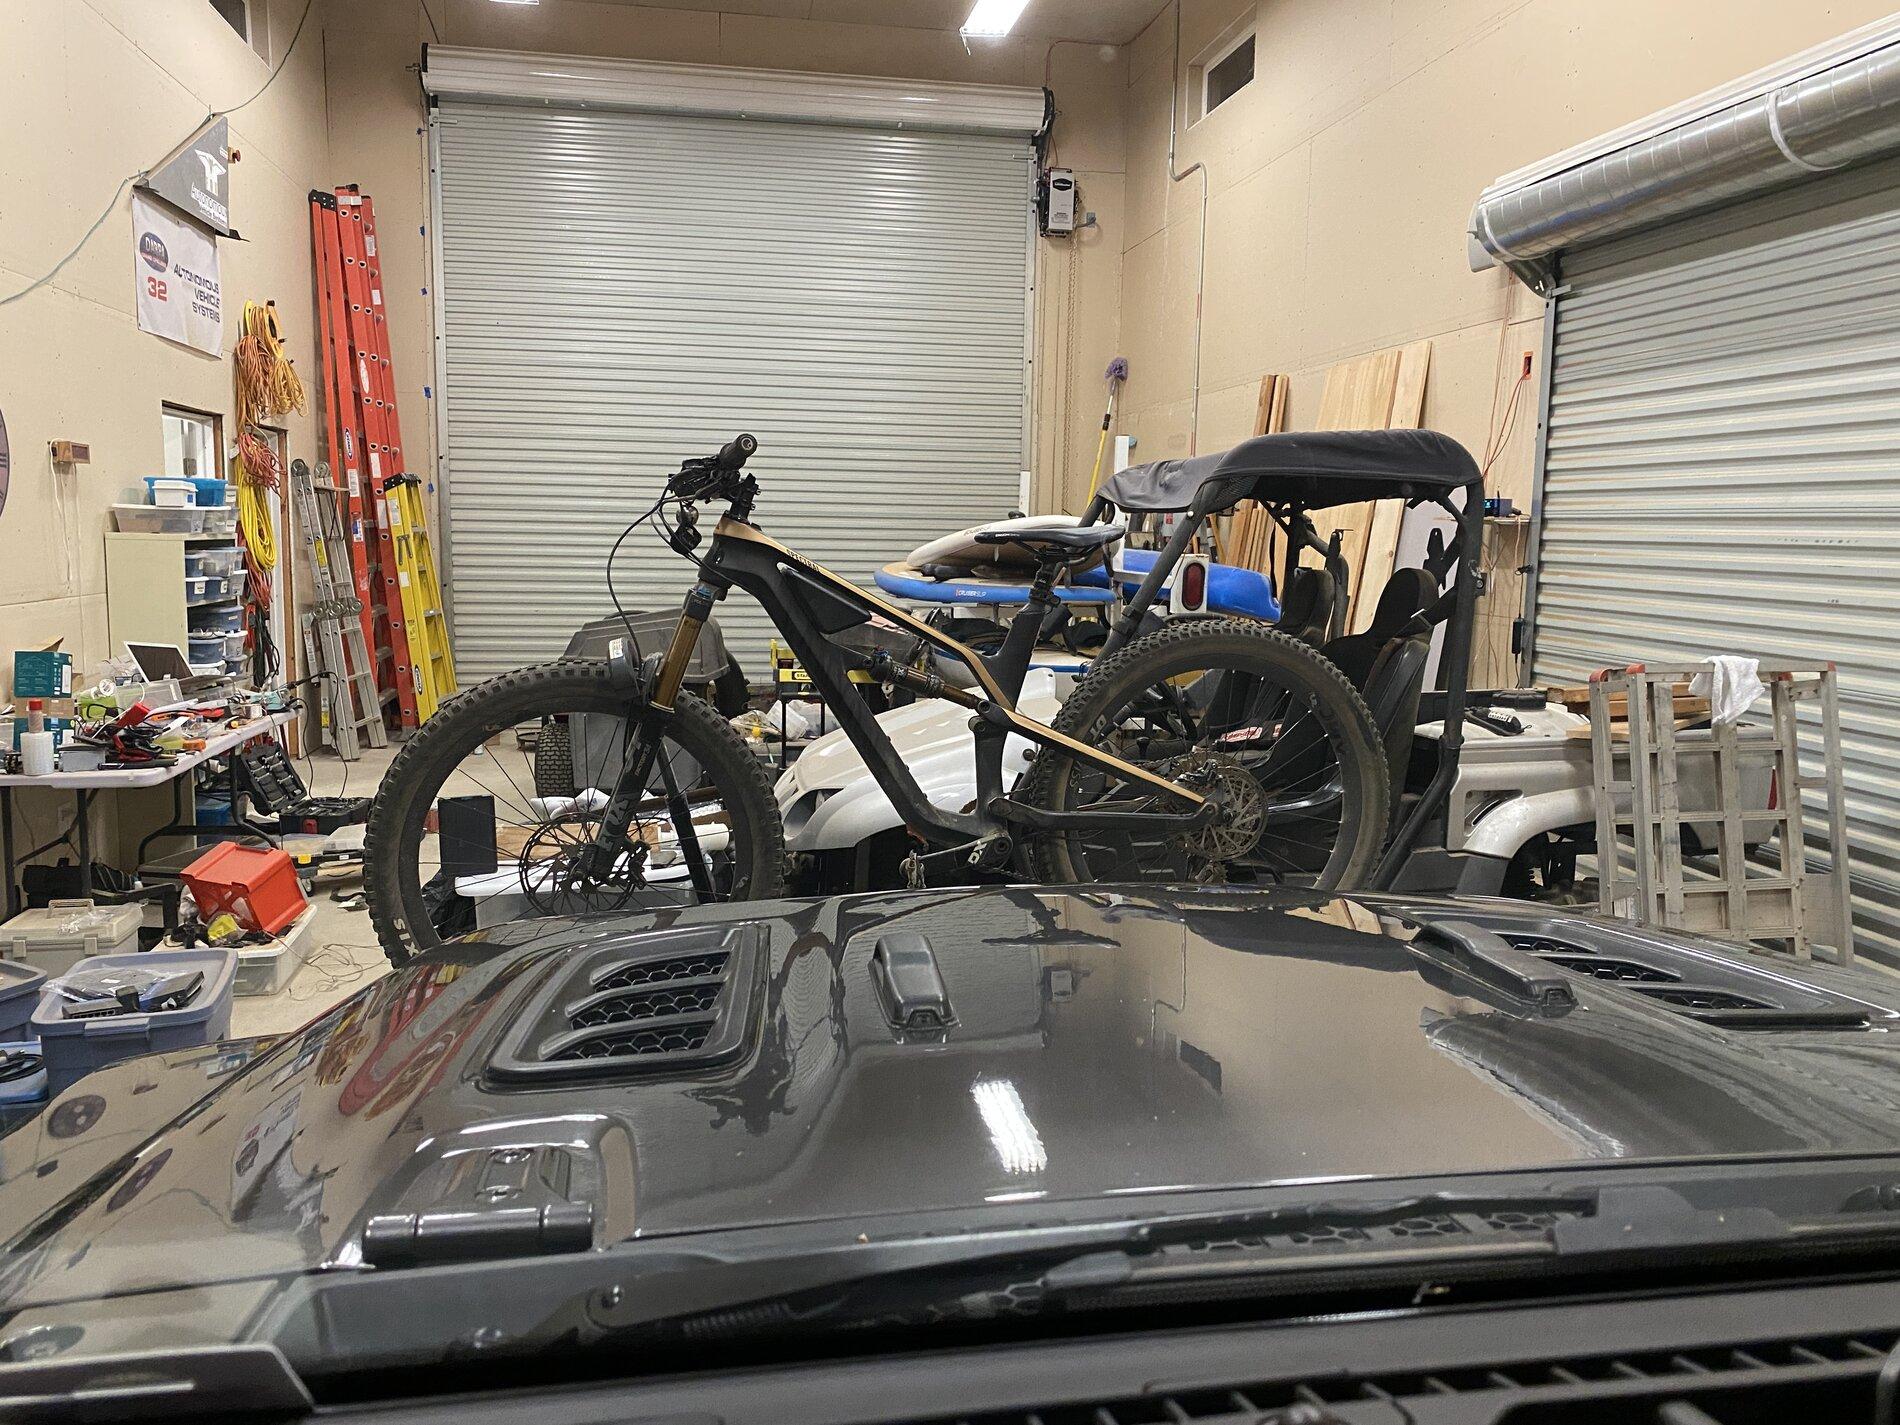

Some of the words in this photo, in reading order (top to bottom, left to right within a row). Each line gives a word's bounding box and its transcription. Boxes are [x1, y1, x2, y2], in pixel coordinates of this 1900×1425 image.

[147, 276, 167, 302] 32
[173, 263, 219, 295] AUTONOMOUS
[191, 301, 220, 323] SYSTEMS
[194, 288, 220, 310] VEHICLE
[393, 918, 420, 957] XIS
